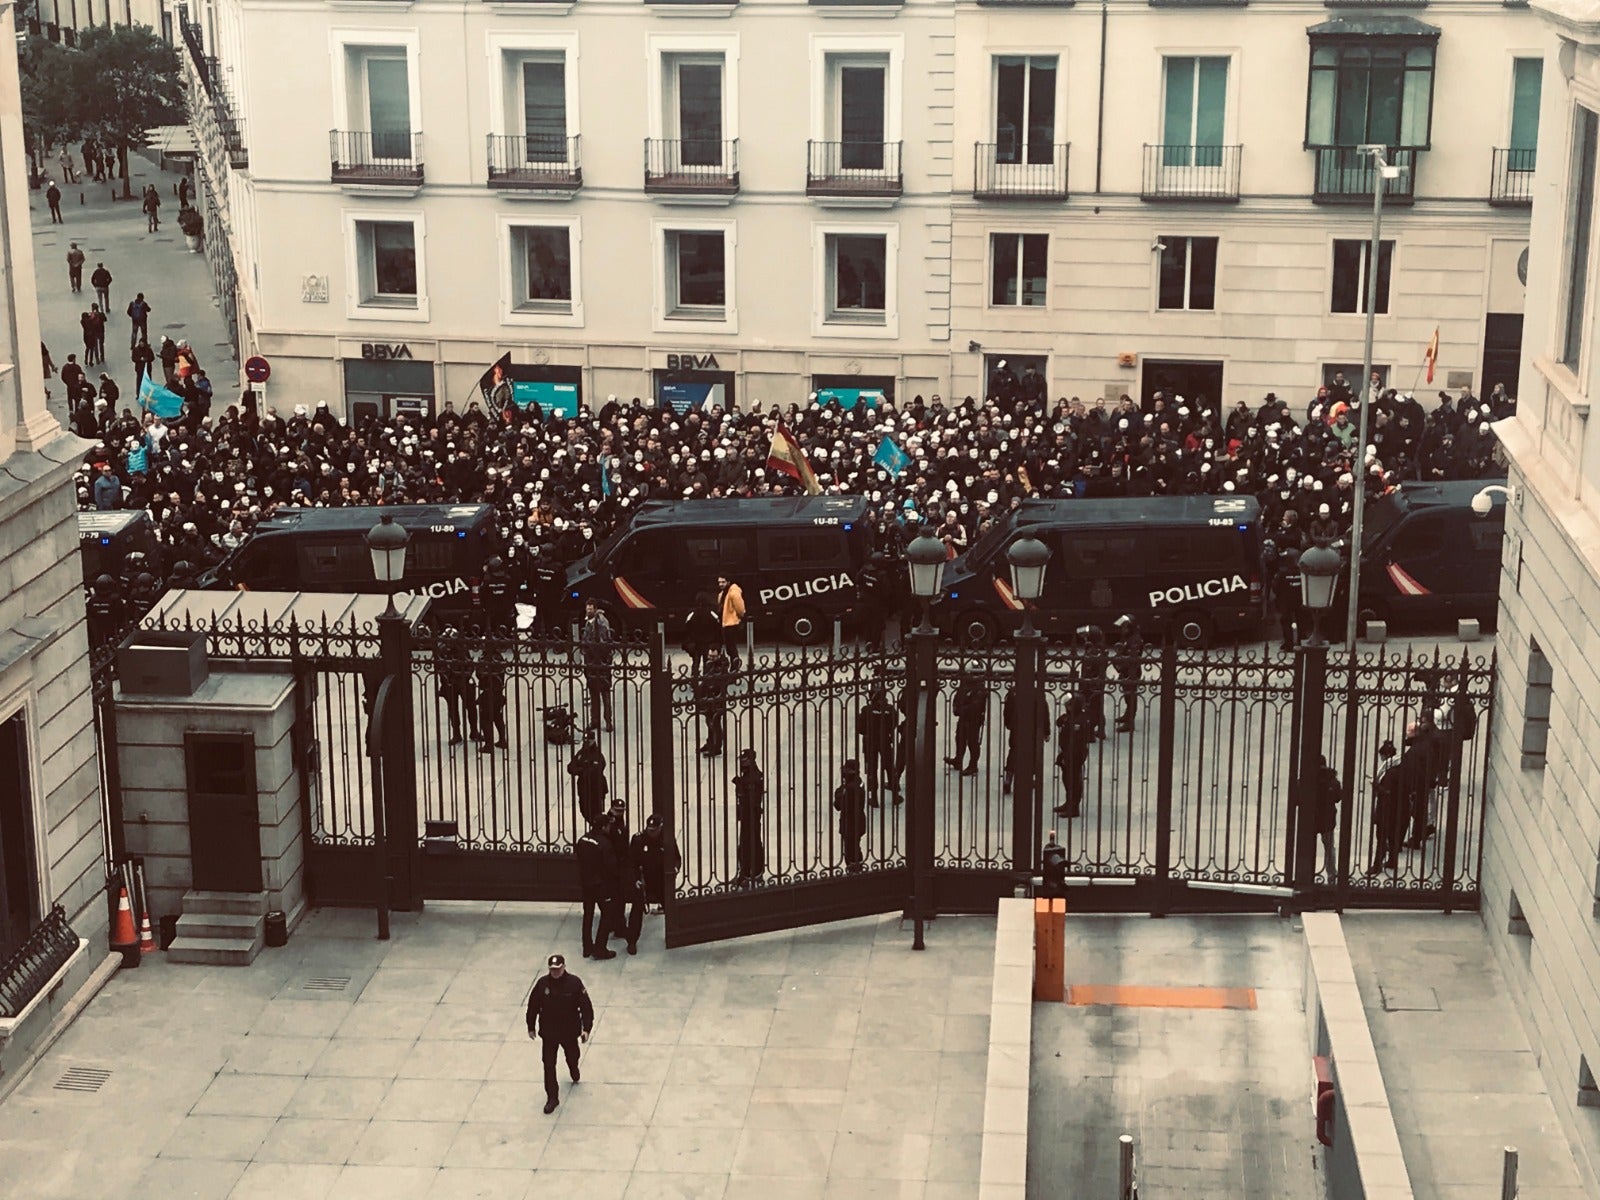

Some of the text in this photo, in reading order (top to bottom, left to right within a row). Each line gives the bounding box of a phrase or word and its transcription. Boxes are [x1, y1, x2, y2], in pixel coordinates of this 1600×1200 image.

[361, 343, 413, 359] BBVA
[667, 353, 720, 370] BBVA
[760, 572, 854, 605] POLICIA
[1149, 574, 1248, 608] POLICIA
